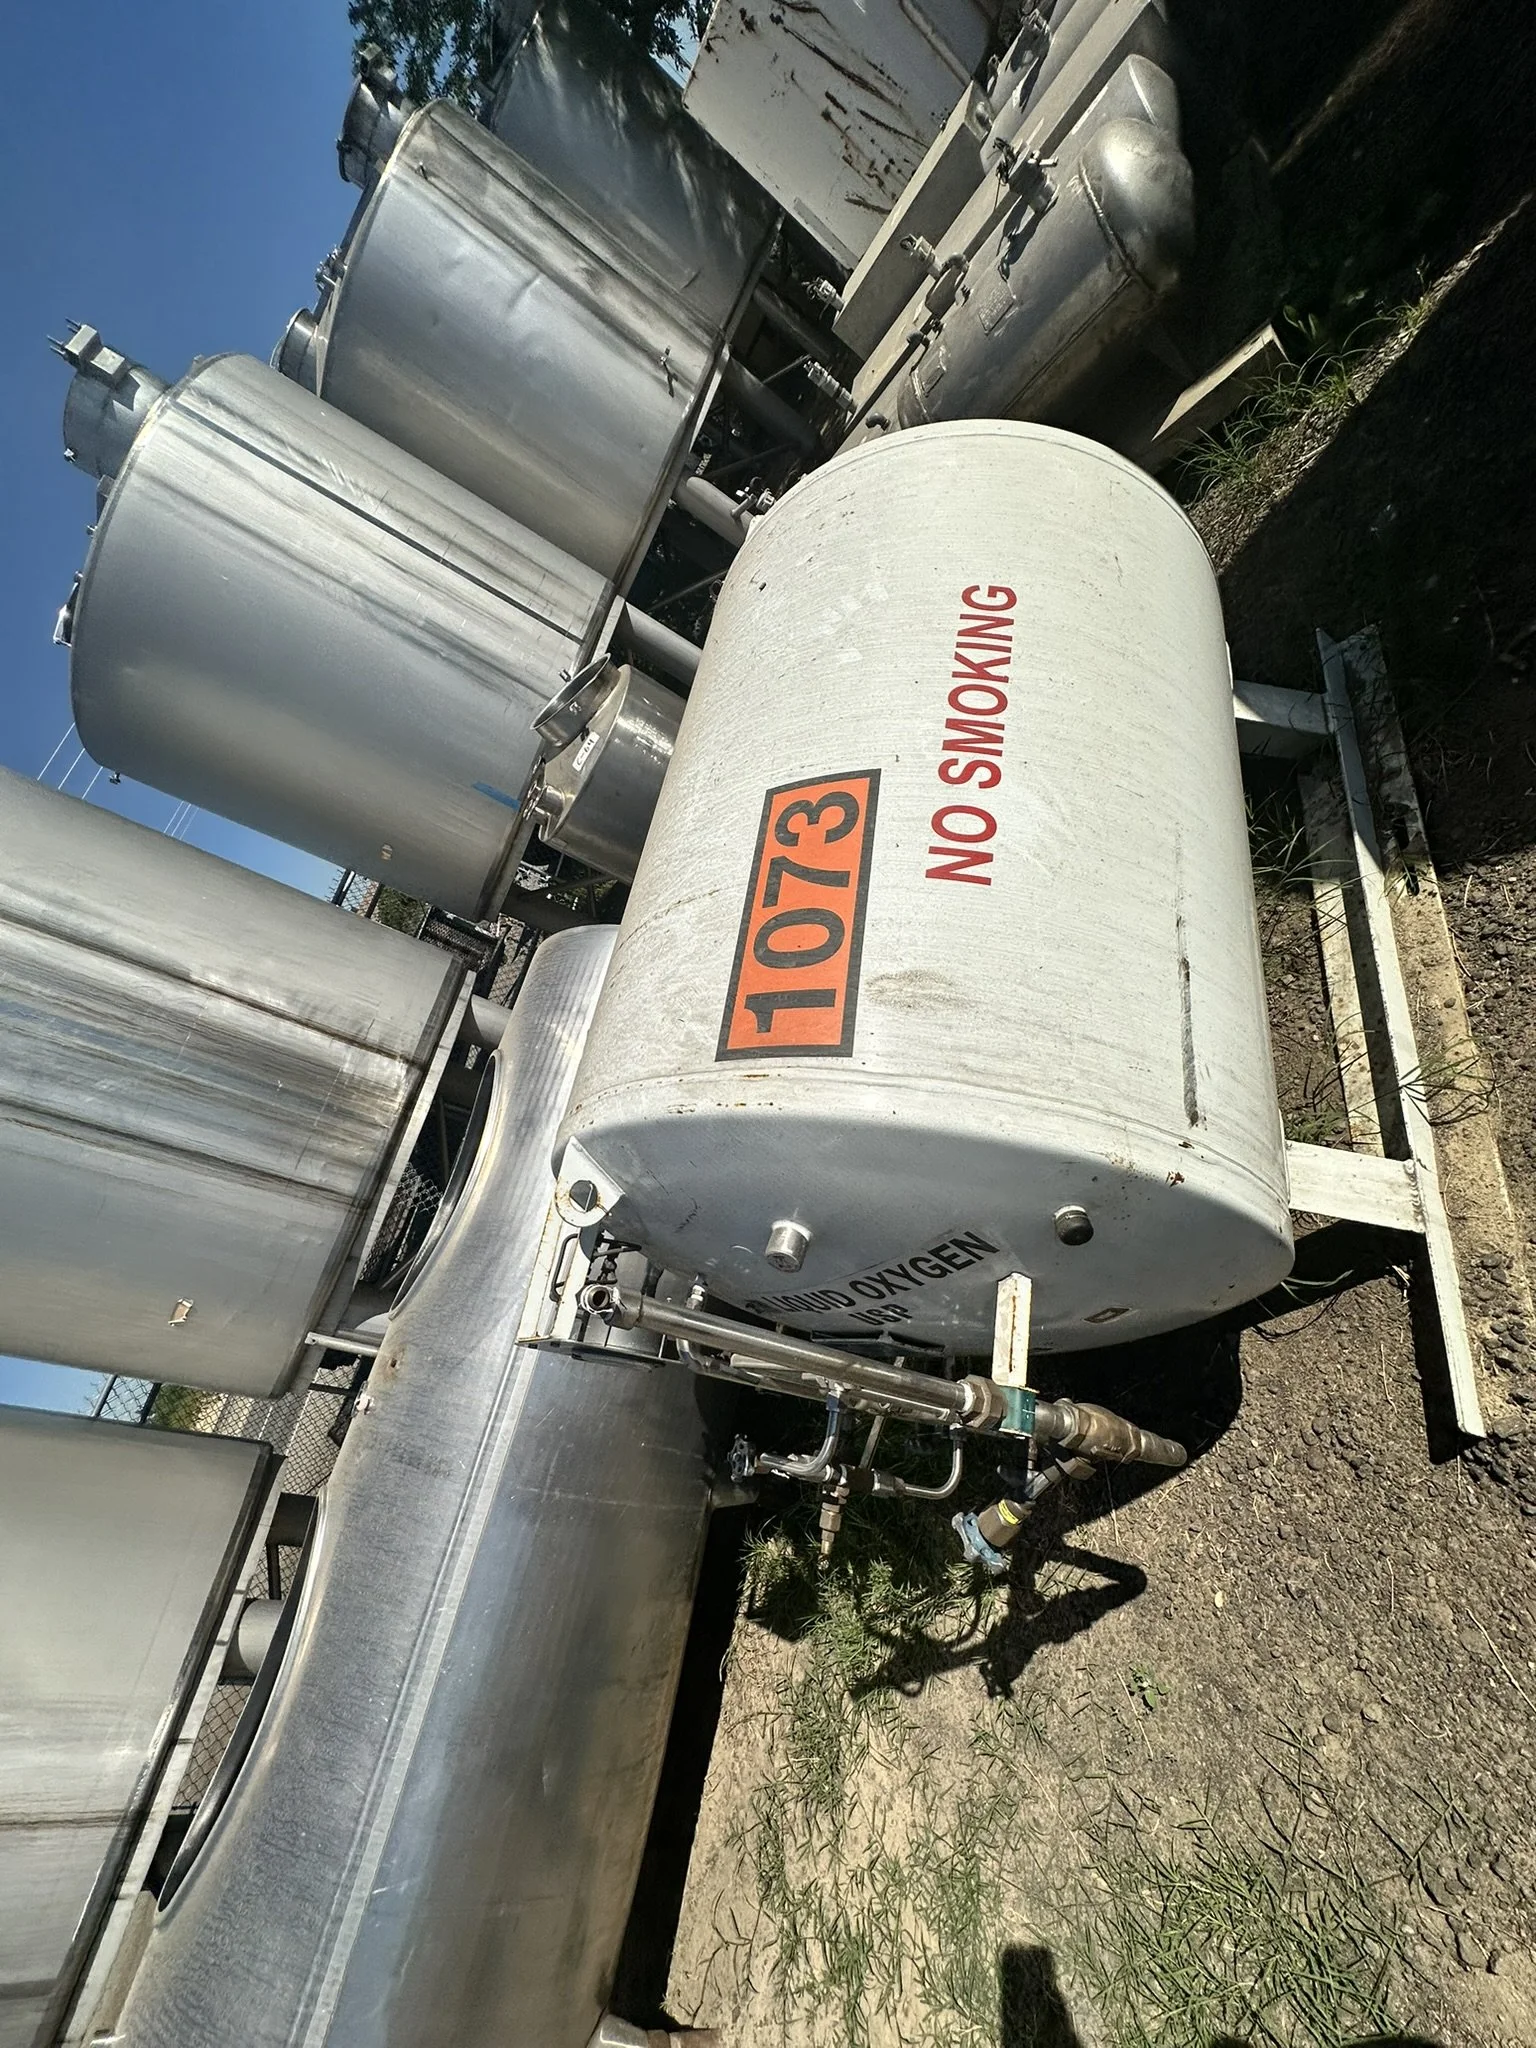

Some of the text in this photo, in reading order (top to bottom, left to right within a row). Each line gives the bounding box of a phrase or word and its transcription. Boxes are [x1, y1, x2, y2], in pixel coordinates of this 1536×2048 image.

[925, 584, 1018, 886] NO SMOKING
[744, 790, 860, 1034] 1073
[761, 1231, 1000, 1314] LIQUID OXYGEN
[849, 1303, 913, 1326] USP
